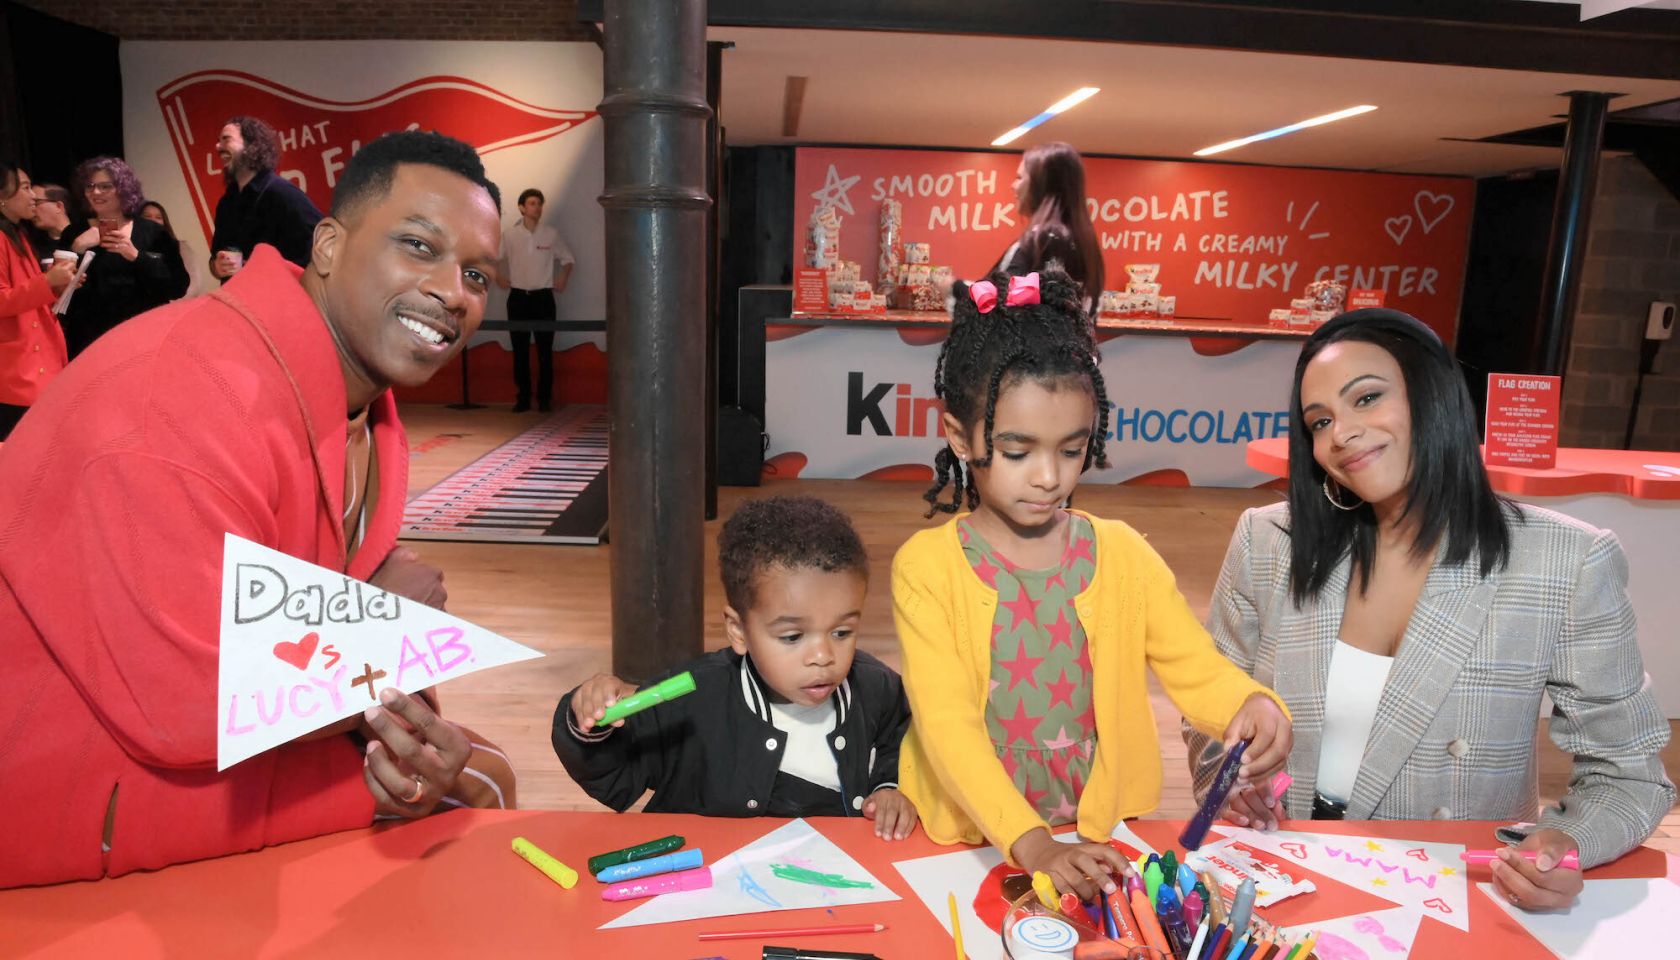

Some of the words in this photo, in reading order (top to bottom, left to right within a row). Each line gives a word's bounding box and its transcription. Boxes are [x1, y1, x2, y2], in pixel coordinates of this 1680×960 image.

[279, 120, 330, 152] HAT
[871, 169, 997, 201] SMOOTH
[928, 202, 1016, 233] MILK
[1101, 230, 1162, 252] WITH
[1173, 232, 1188, 252] A
[1199, 234, 1288, 256] CREAMY
[1194, 260, 1298, 293] MILKY
[1314, 264, 1439, 296] CENTER
[1498, 379, 1515, 389] FLAG
[1518, 380, 1551, 390] CREATION
[234, 562, 401, 625] Dada
[225, 664, 348, 736] LUCY
[1205, 855, 1259, 884] inder
[1324, 846, 1437, 888] MAMA
